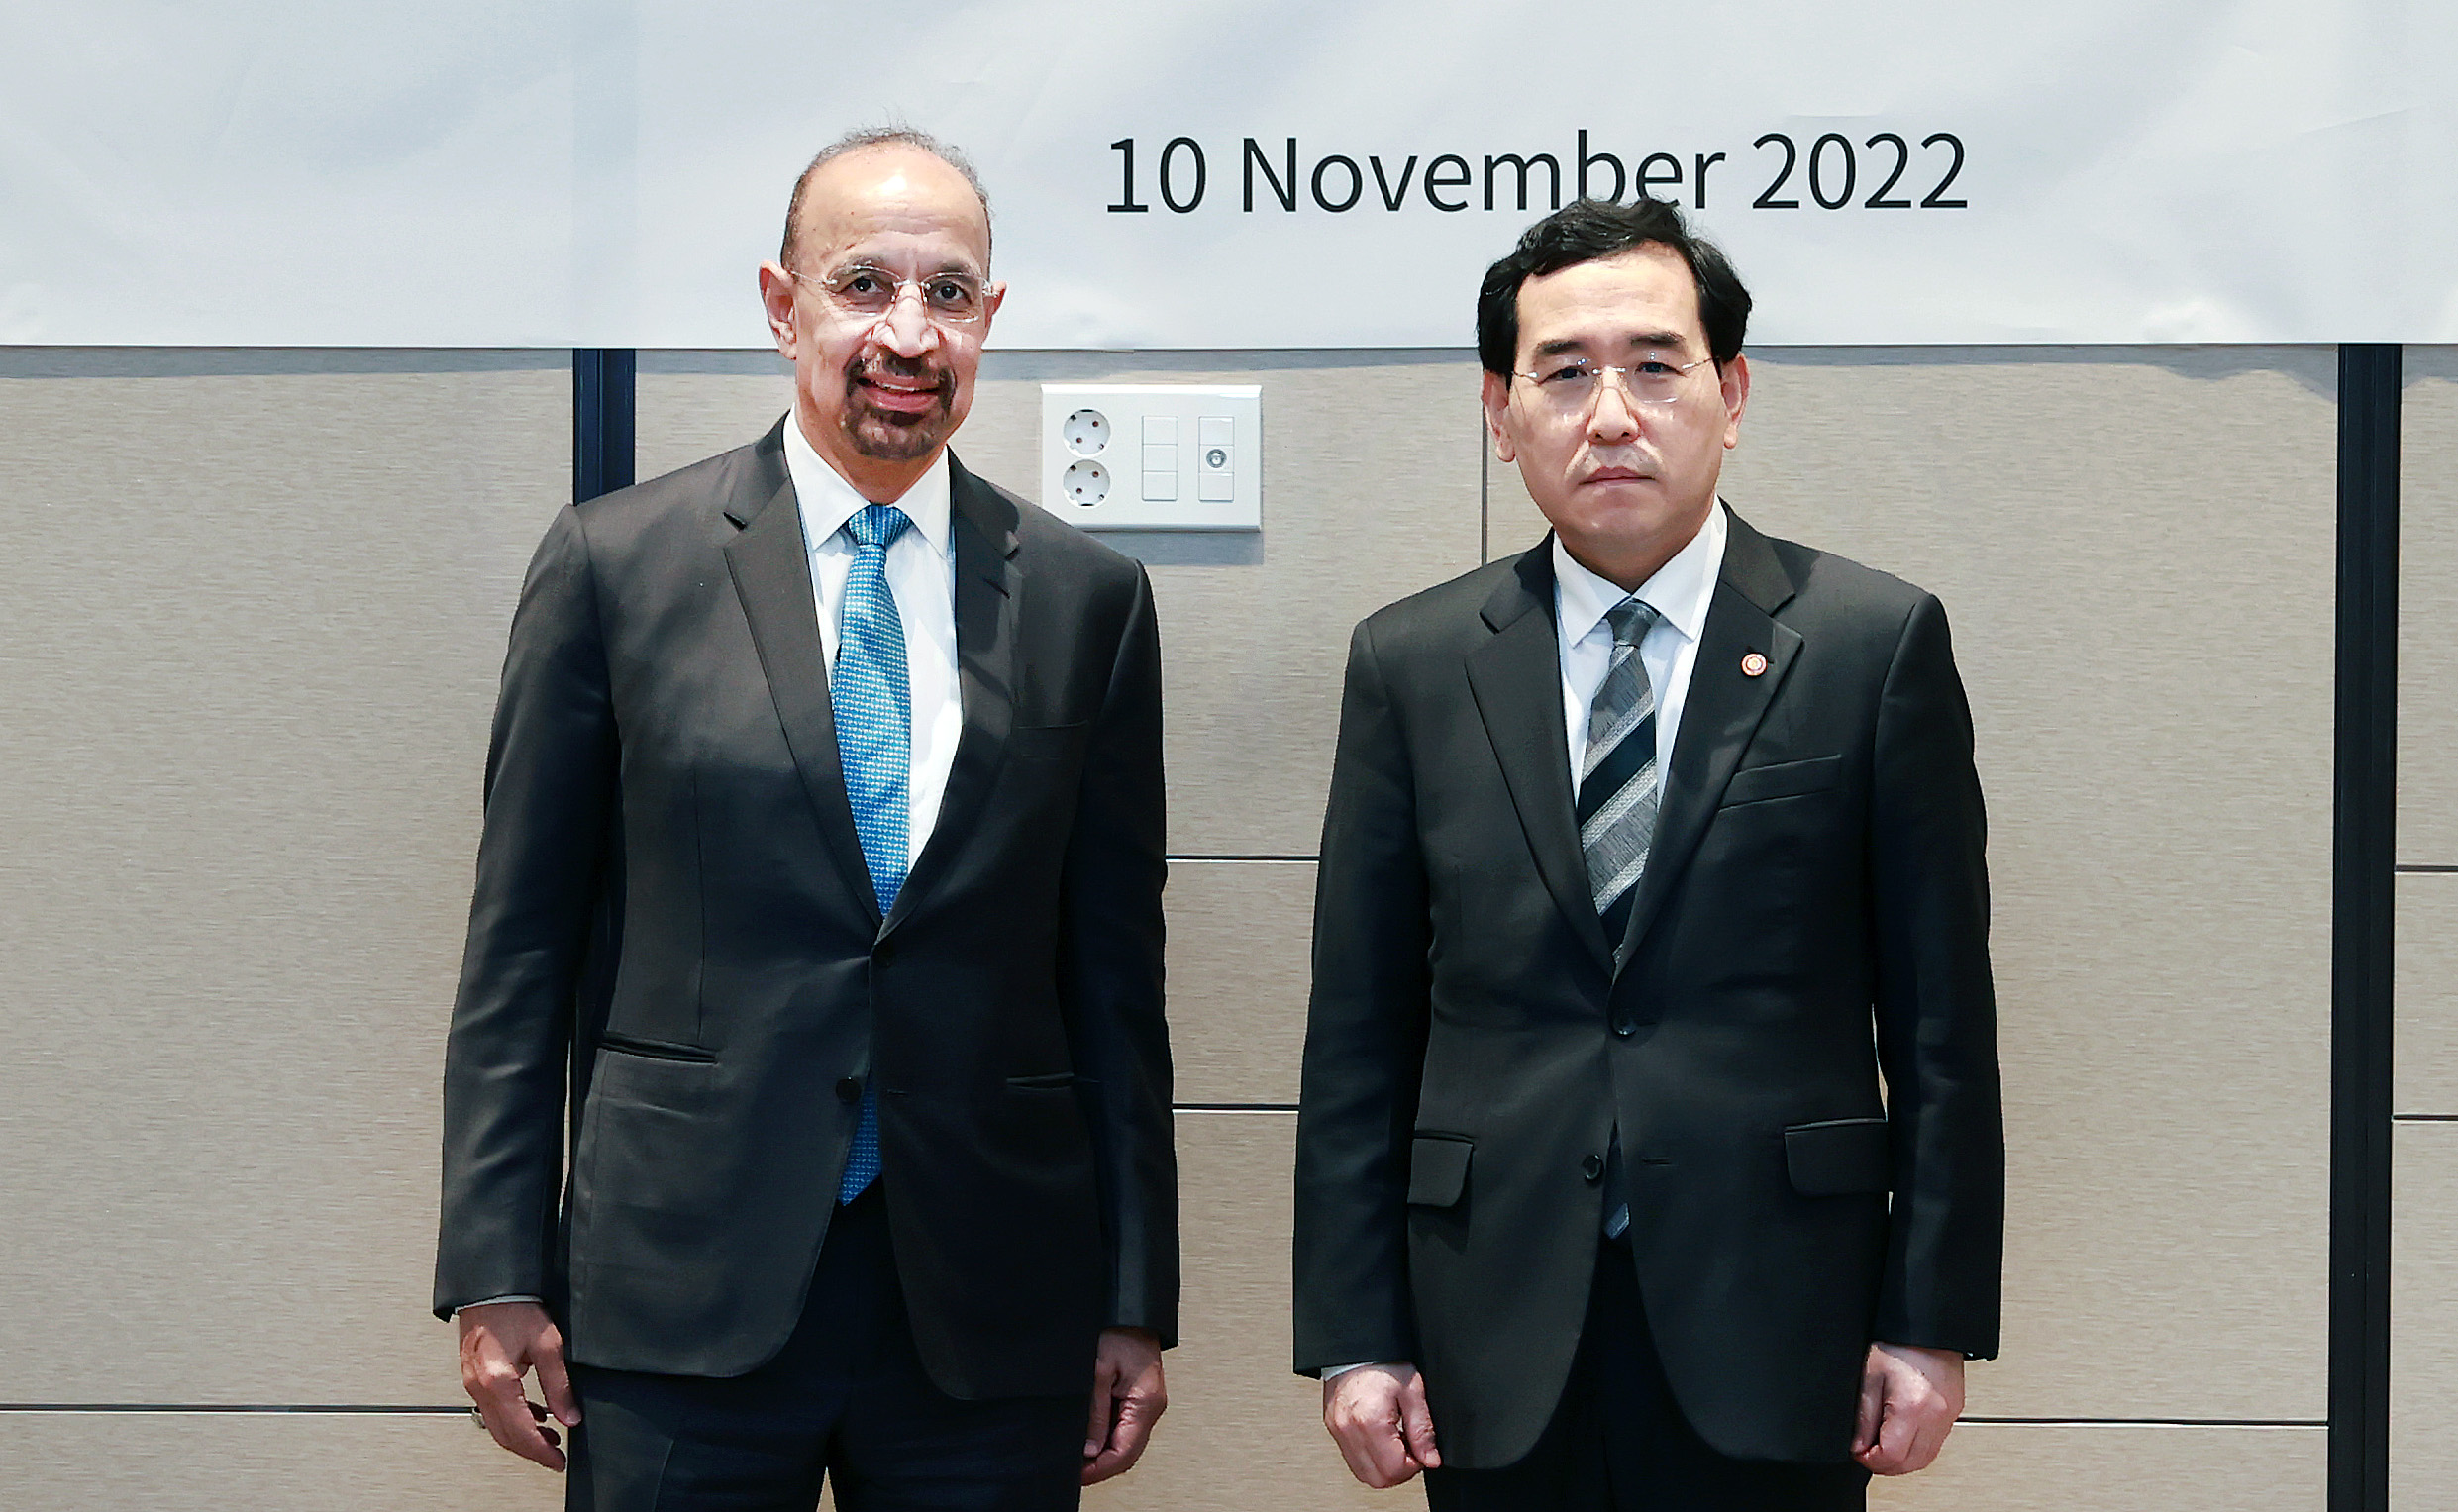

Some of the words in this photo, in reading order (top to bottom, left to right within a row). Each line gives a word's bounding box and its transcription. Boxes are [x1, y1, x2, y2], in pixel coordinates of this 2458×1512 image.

[1106, 136, 1206, 214] 10
[1243, 129, 1727, 213] November
[1752, 132, 1968, 210] 2022
